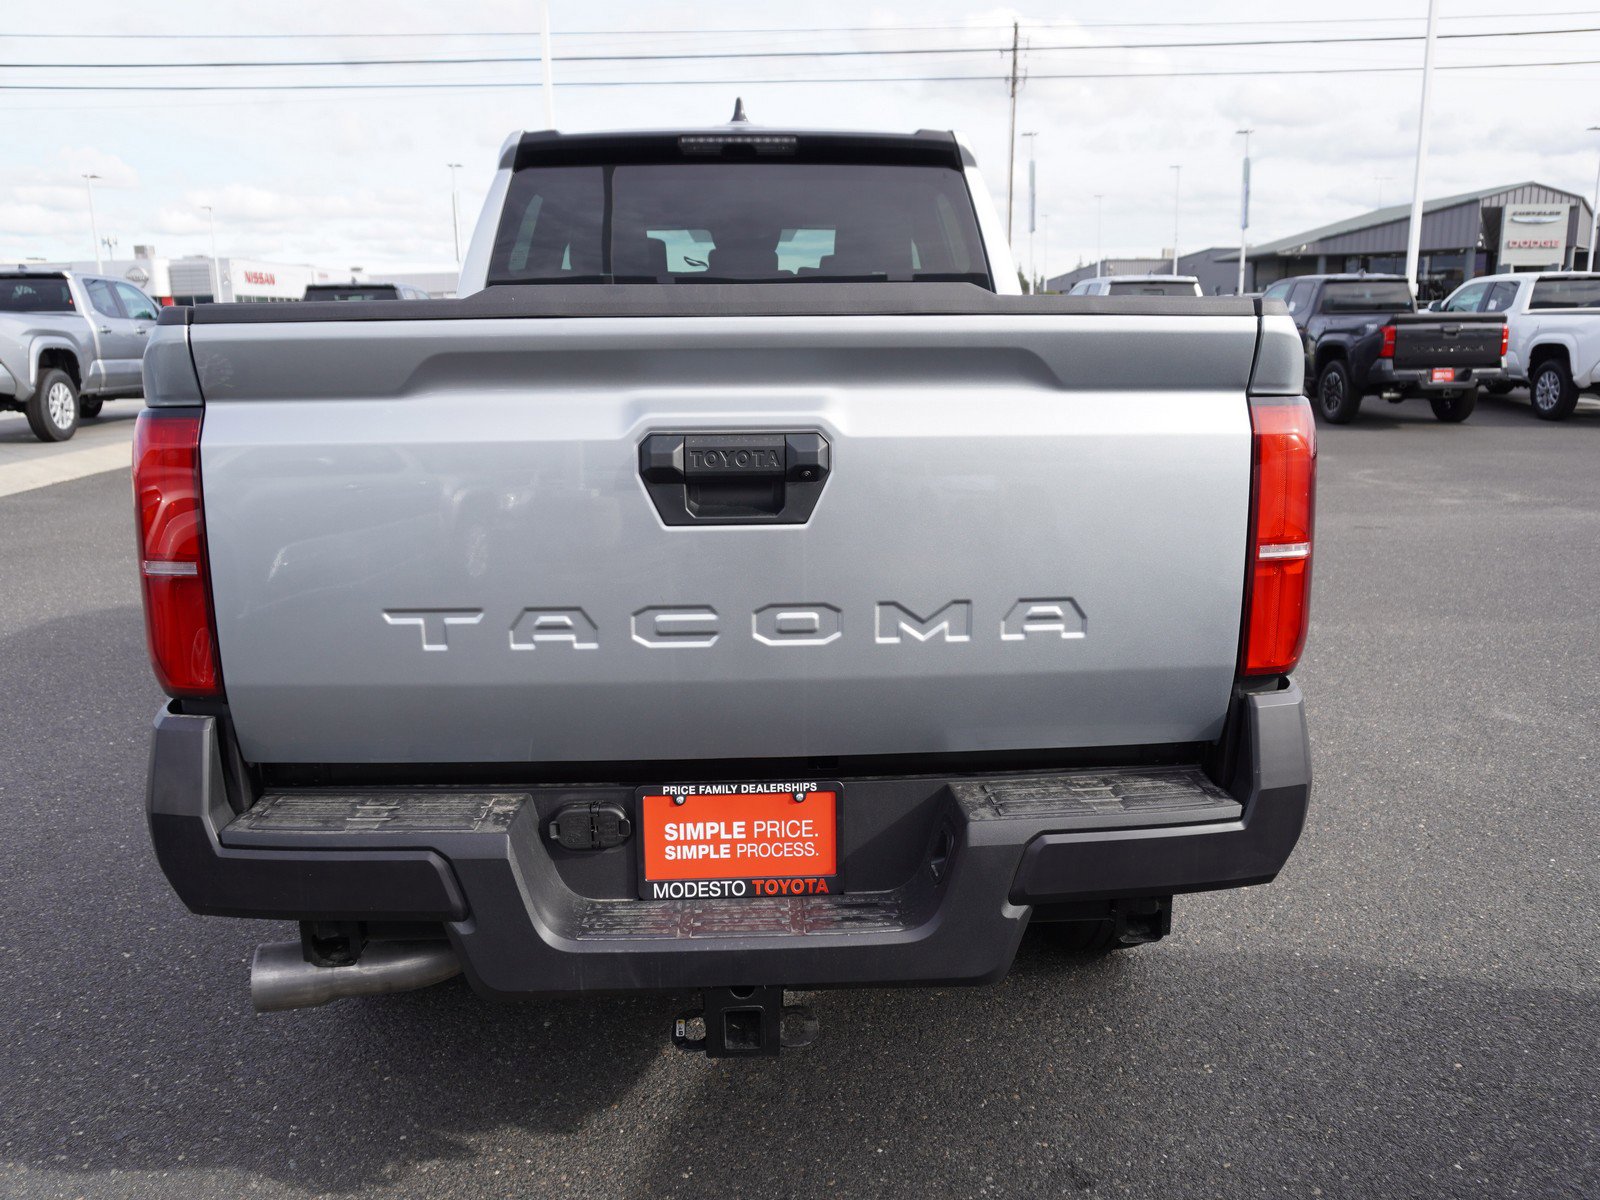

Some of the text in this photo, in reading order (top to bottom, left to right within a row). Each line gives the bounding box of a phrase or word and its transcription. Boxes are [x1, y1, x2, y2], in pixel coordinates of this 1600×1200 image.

[1508, 239, 1560, 249] DODGE
[244, 271, 276, 286] NISSAN
[689, 449, 781, 468] TOYOTA
[382, 597, 1088, 651] TACOMA
[662, 782, 817, 795] PRICE FAMILY DEALERSHIPS
[664, 819, 819, 841] SIMPLE PRICE.
[664, 841, 820, 860] SIMPLE PROCESS.
[653, 878, 829, 899] MODESTO TOYOTA
